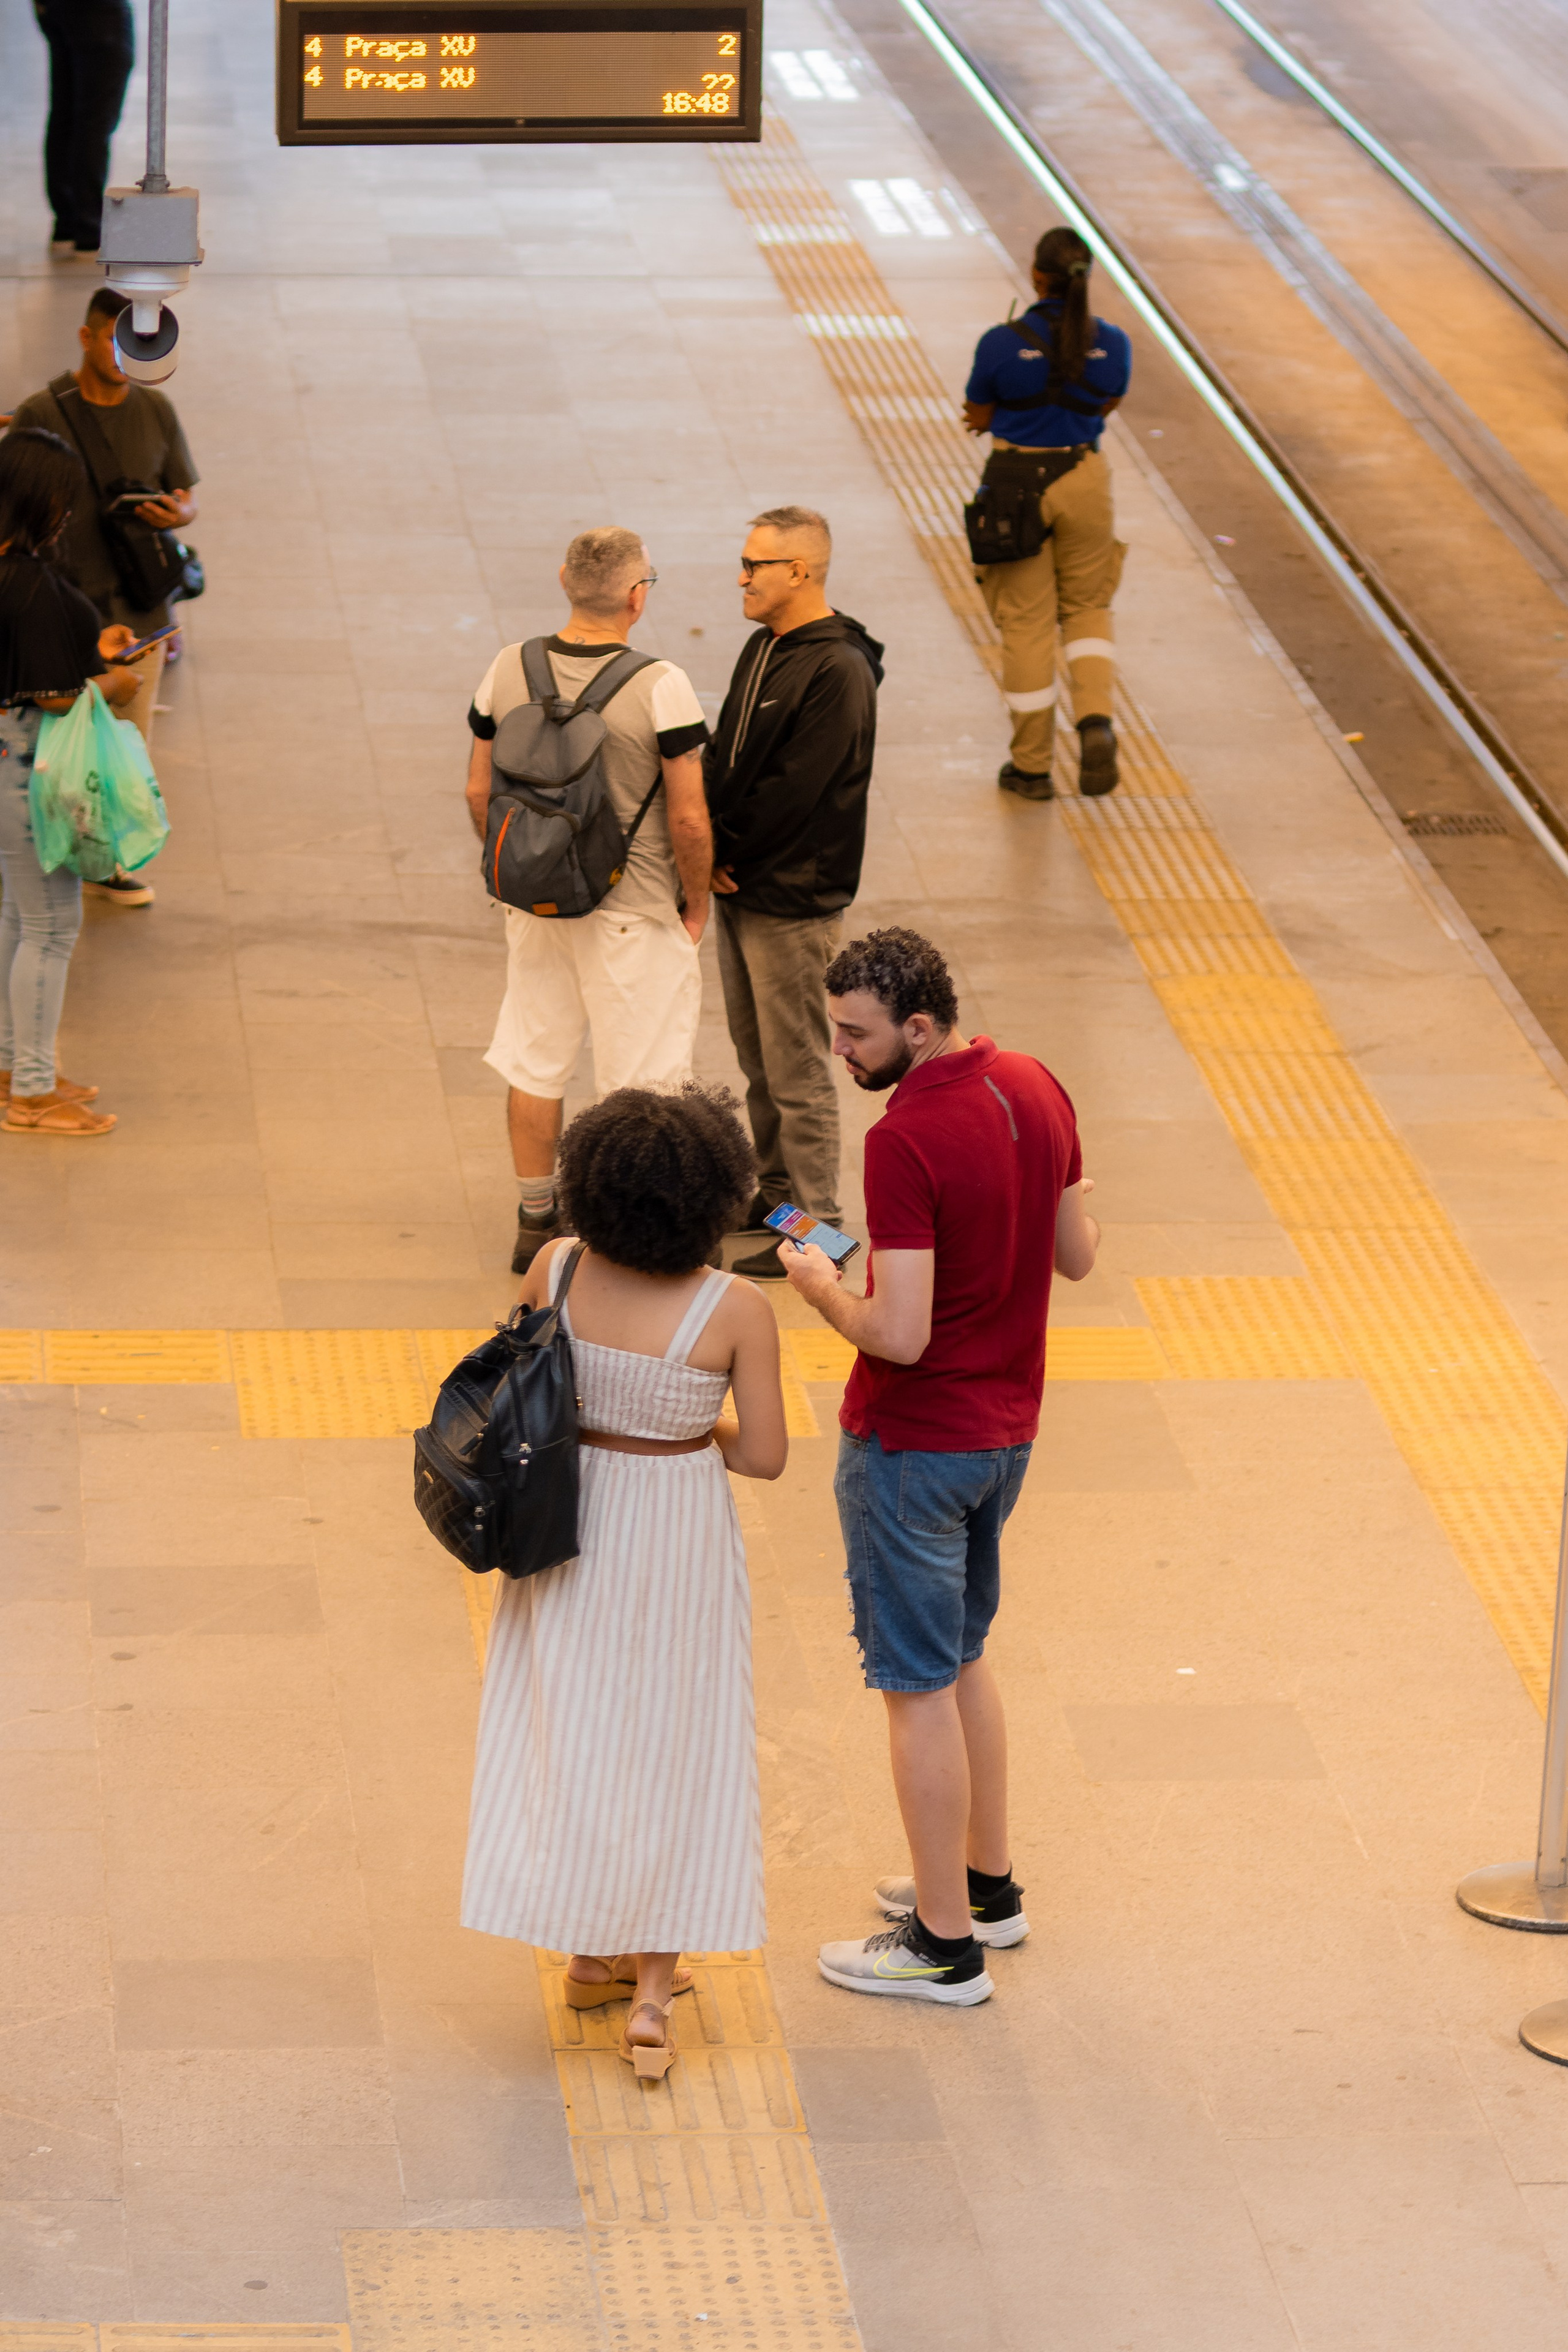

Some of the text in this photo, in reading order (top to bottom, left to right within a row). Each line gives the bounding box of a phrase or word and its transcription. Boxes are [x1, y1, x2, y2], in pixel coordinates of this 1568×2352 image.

[304, 34, 737, 62] 4 Praça XV 2
[304, 66, 323, 87] 4
[440, 67, 476, 88] XV
[662, 92, 730, 113] 16:48
